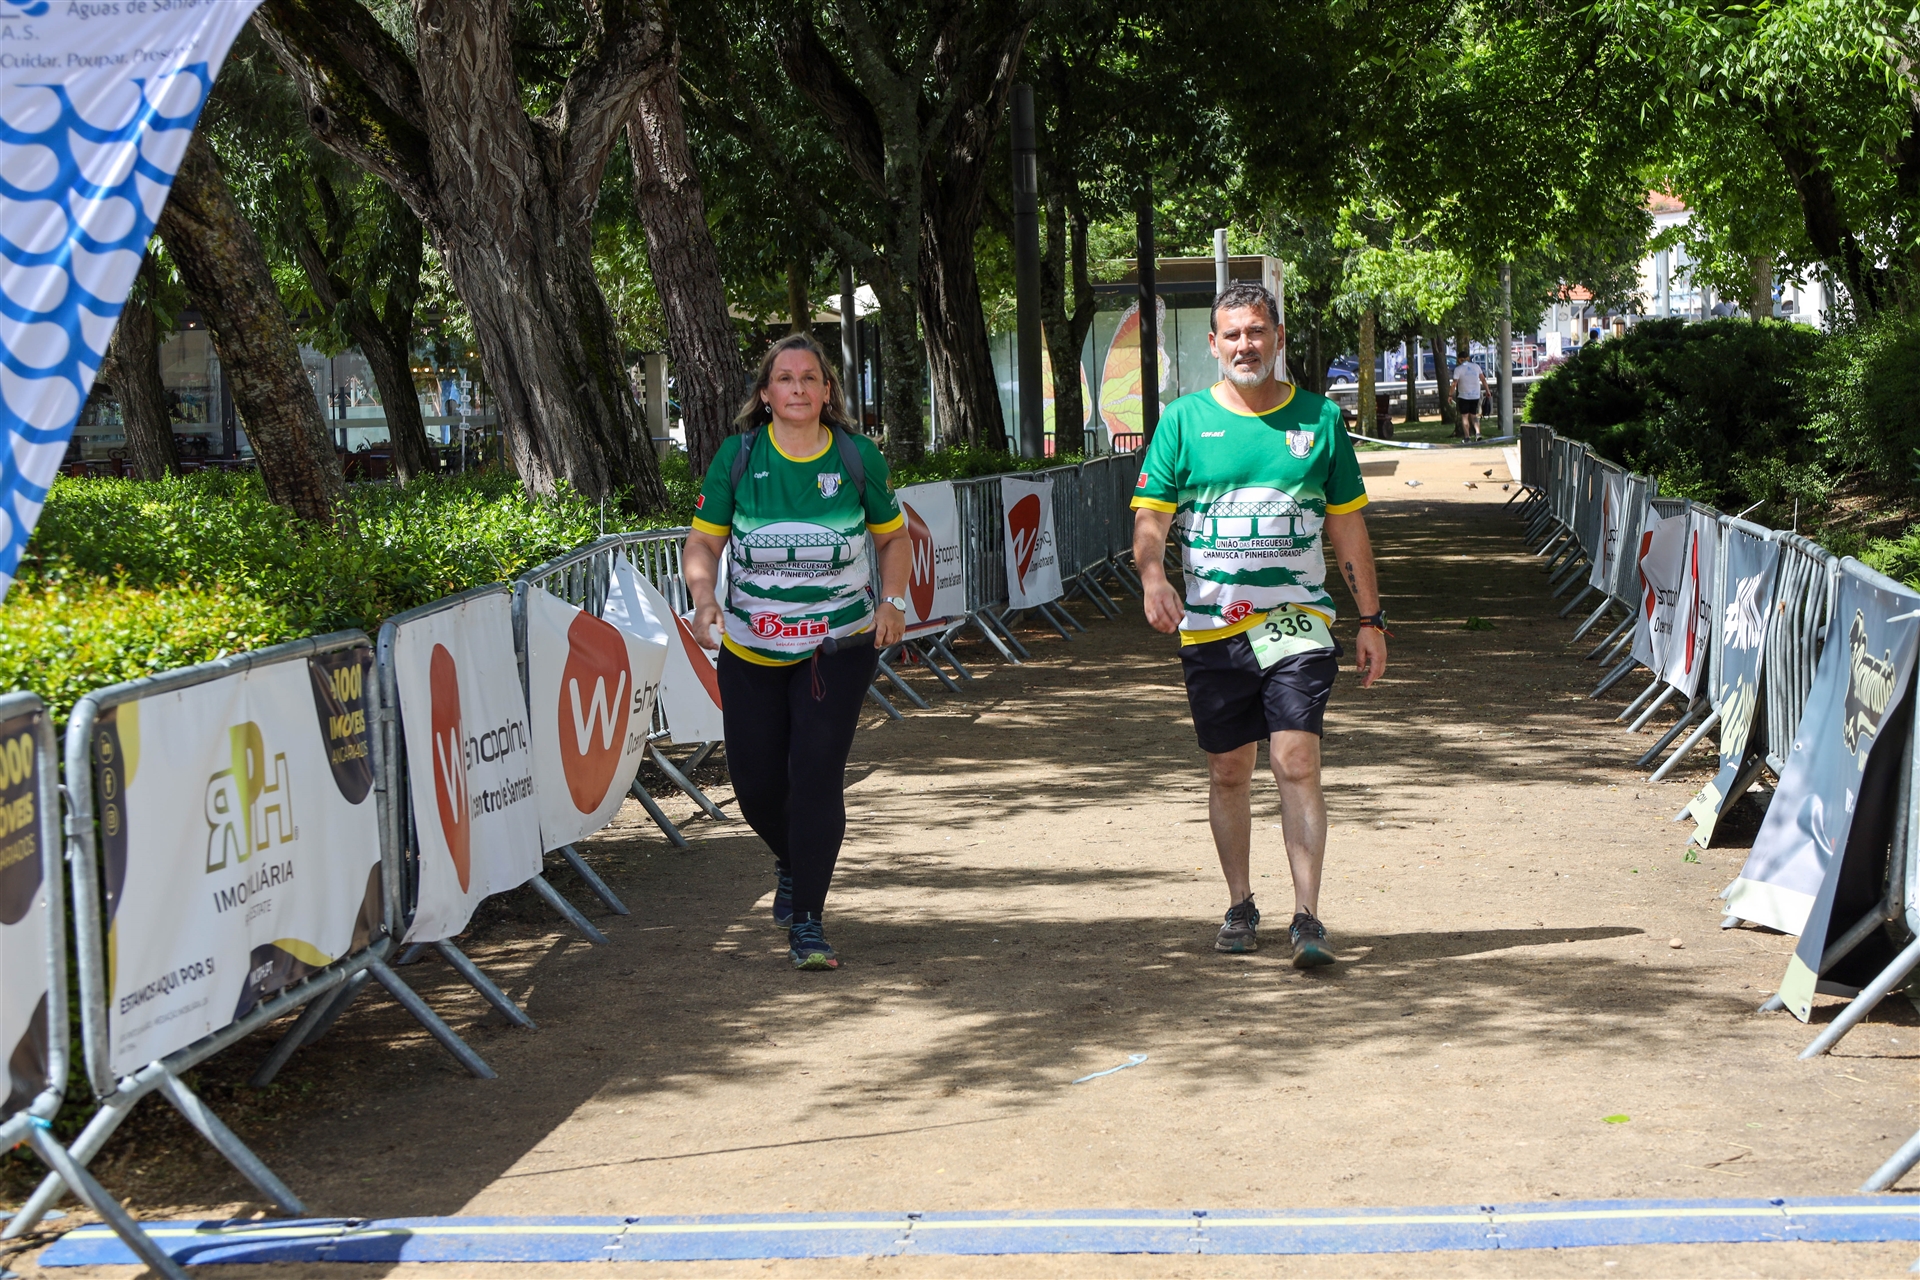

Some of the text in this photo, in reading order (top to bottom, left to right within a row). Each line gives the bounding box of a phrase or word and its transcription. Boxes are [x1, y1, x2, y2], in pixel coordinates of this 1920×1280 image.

[1, 53, 61, 69] Cuidar.
[67, 52, 128, 69] Poupar.
[1216, 538, 1238, 549] UNIÃO
[1251, 539, 1292, 548] FREGUESIAS
[1203, 551, 1239, 560] CHAMUSCA
[1245, 550, 1278, 559] PINHEIRO
[1279, 549, 1302, 558] GRANDE
[788, 561, 832, 570] FREGUESIAS
[780, 570, 814, 579] PINHEIRO
[1265, 613, 1313, 642] 336
[569, 669, 627, 756] W
[156, 968, 181, 996] AQUI
[181, 961, 204, 986] POR
[206, 956, 216, 976] SI
